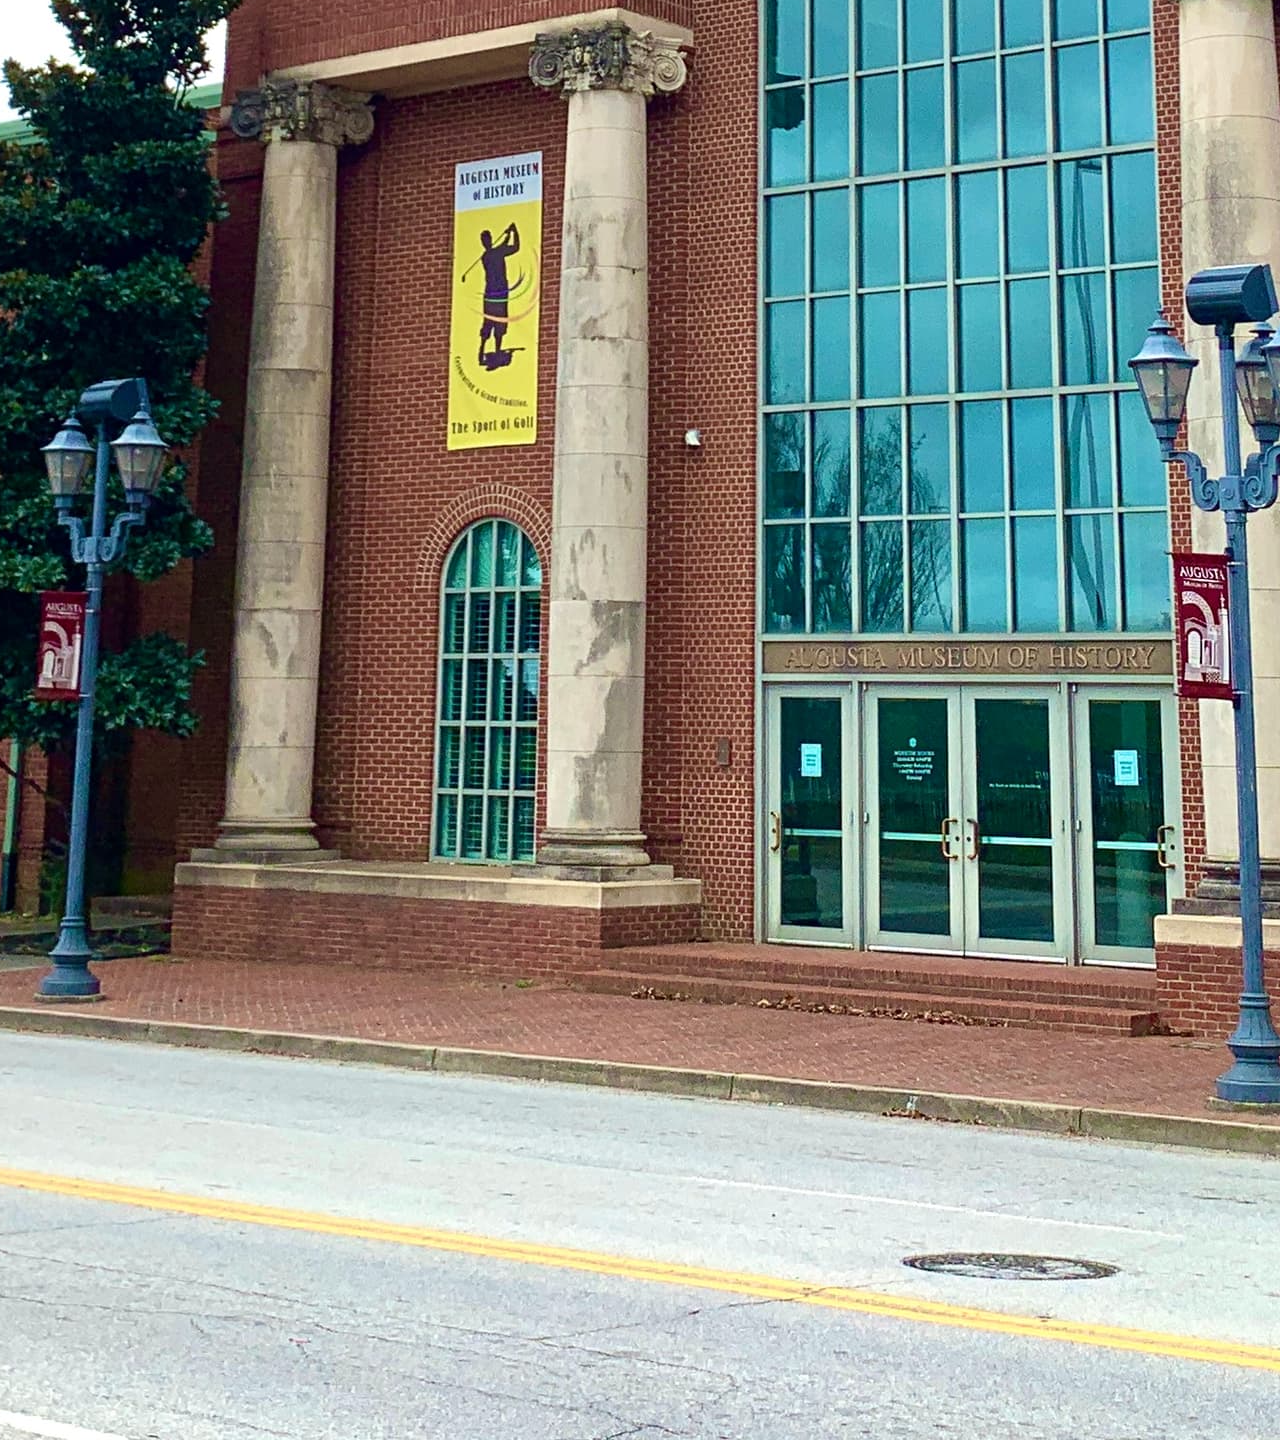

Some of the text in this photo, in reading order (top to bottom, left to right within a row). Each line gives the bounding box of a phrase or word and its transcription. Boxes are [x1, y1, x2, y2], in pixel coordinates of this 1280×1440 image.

[459, 162, 539, 186] AUGUSTA MUSEUM
[473, 182, 525, 201] of HISTORY
[452, 416, 534, 435] The Sport of Golf
[1179, 566, 1225, 580] AUGUSTA
[45, 602, 82, 613] AUGUSTA
[784, 646, 1156, 670] AUGUSTA MUSEUM OF HISTORY
